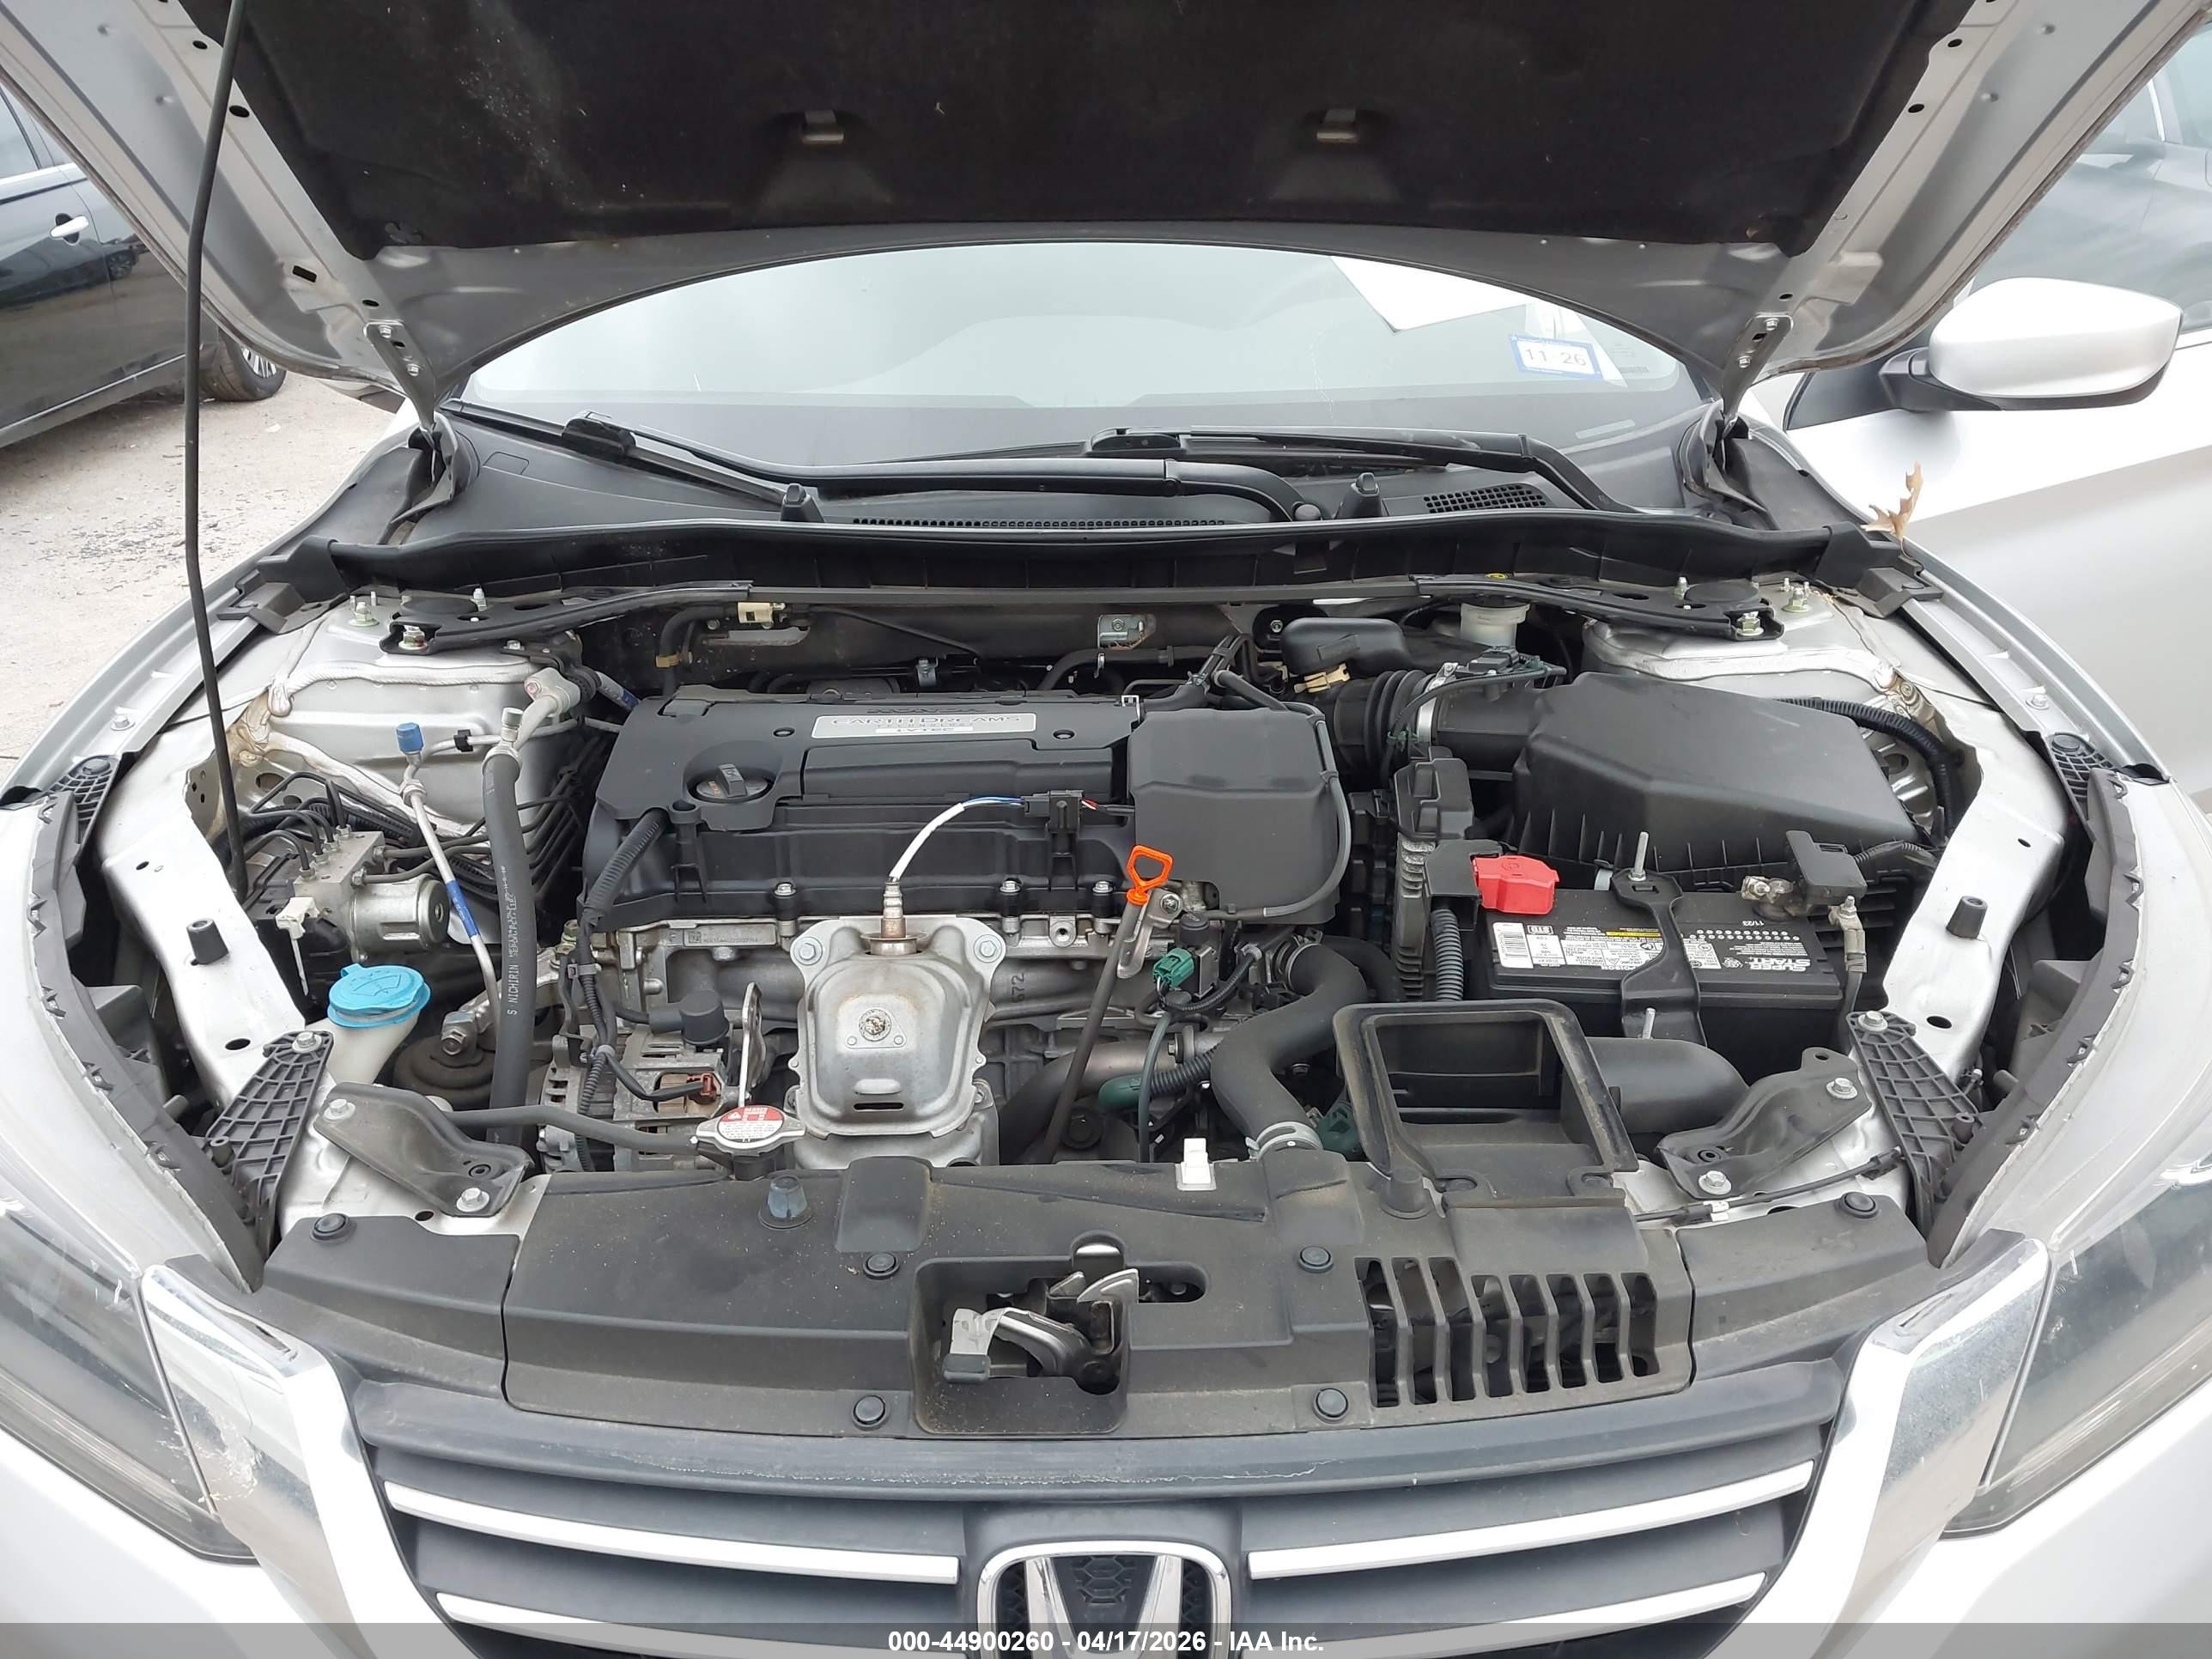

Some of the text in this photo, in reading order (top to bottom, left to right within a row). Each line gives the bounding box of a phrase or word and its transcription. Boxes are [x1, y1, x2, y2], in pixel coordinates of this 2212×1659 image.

[1525, 348, 1588, 367] 11 26
[1748, 957, 1811, 967] START
[507, 964, 520, 1004] NICHIRIN
